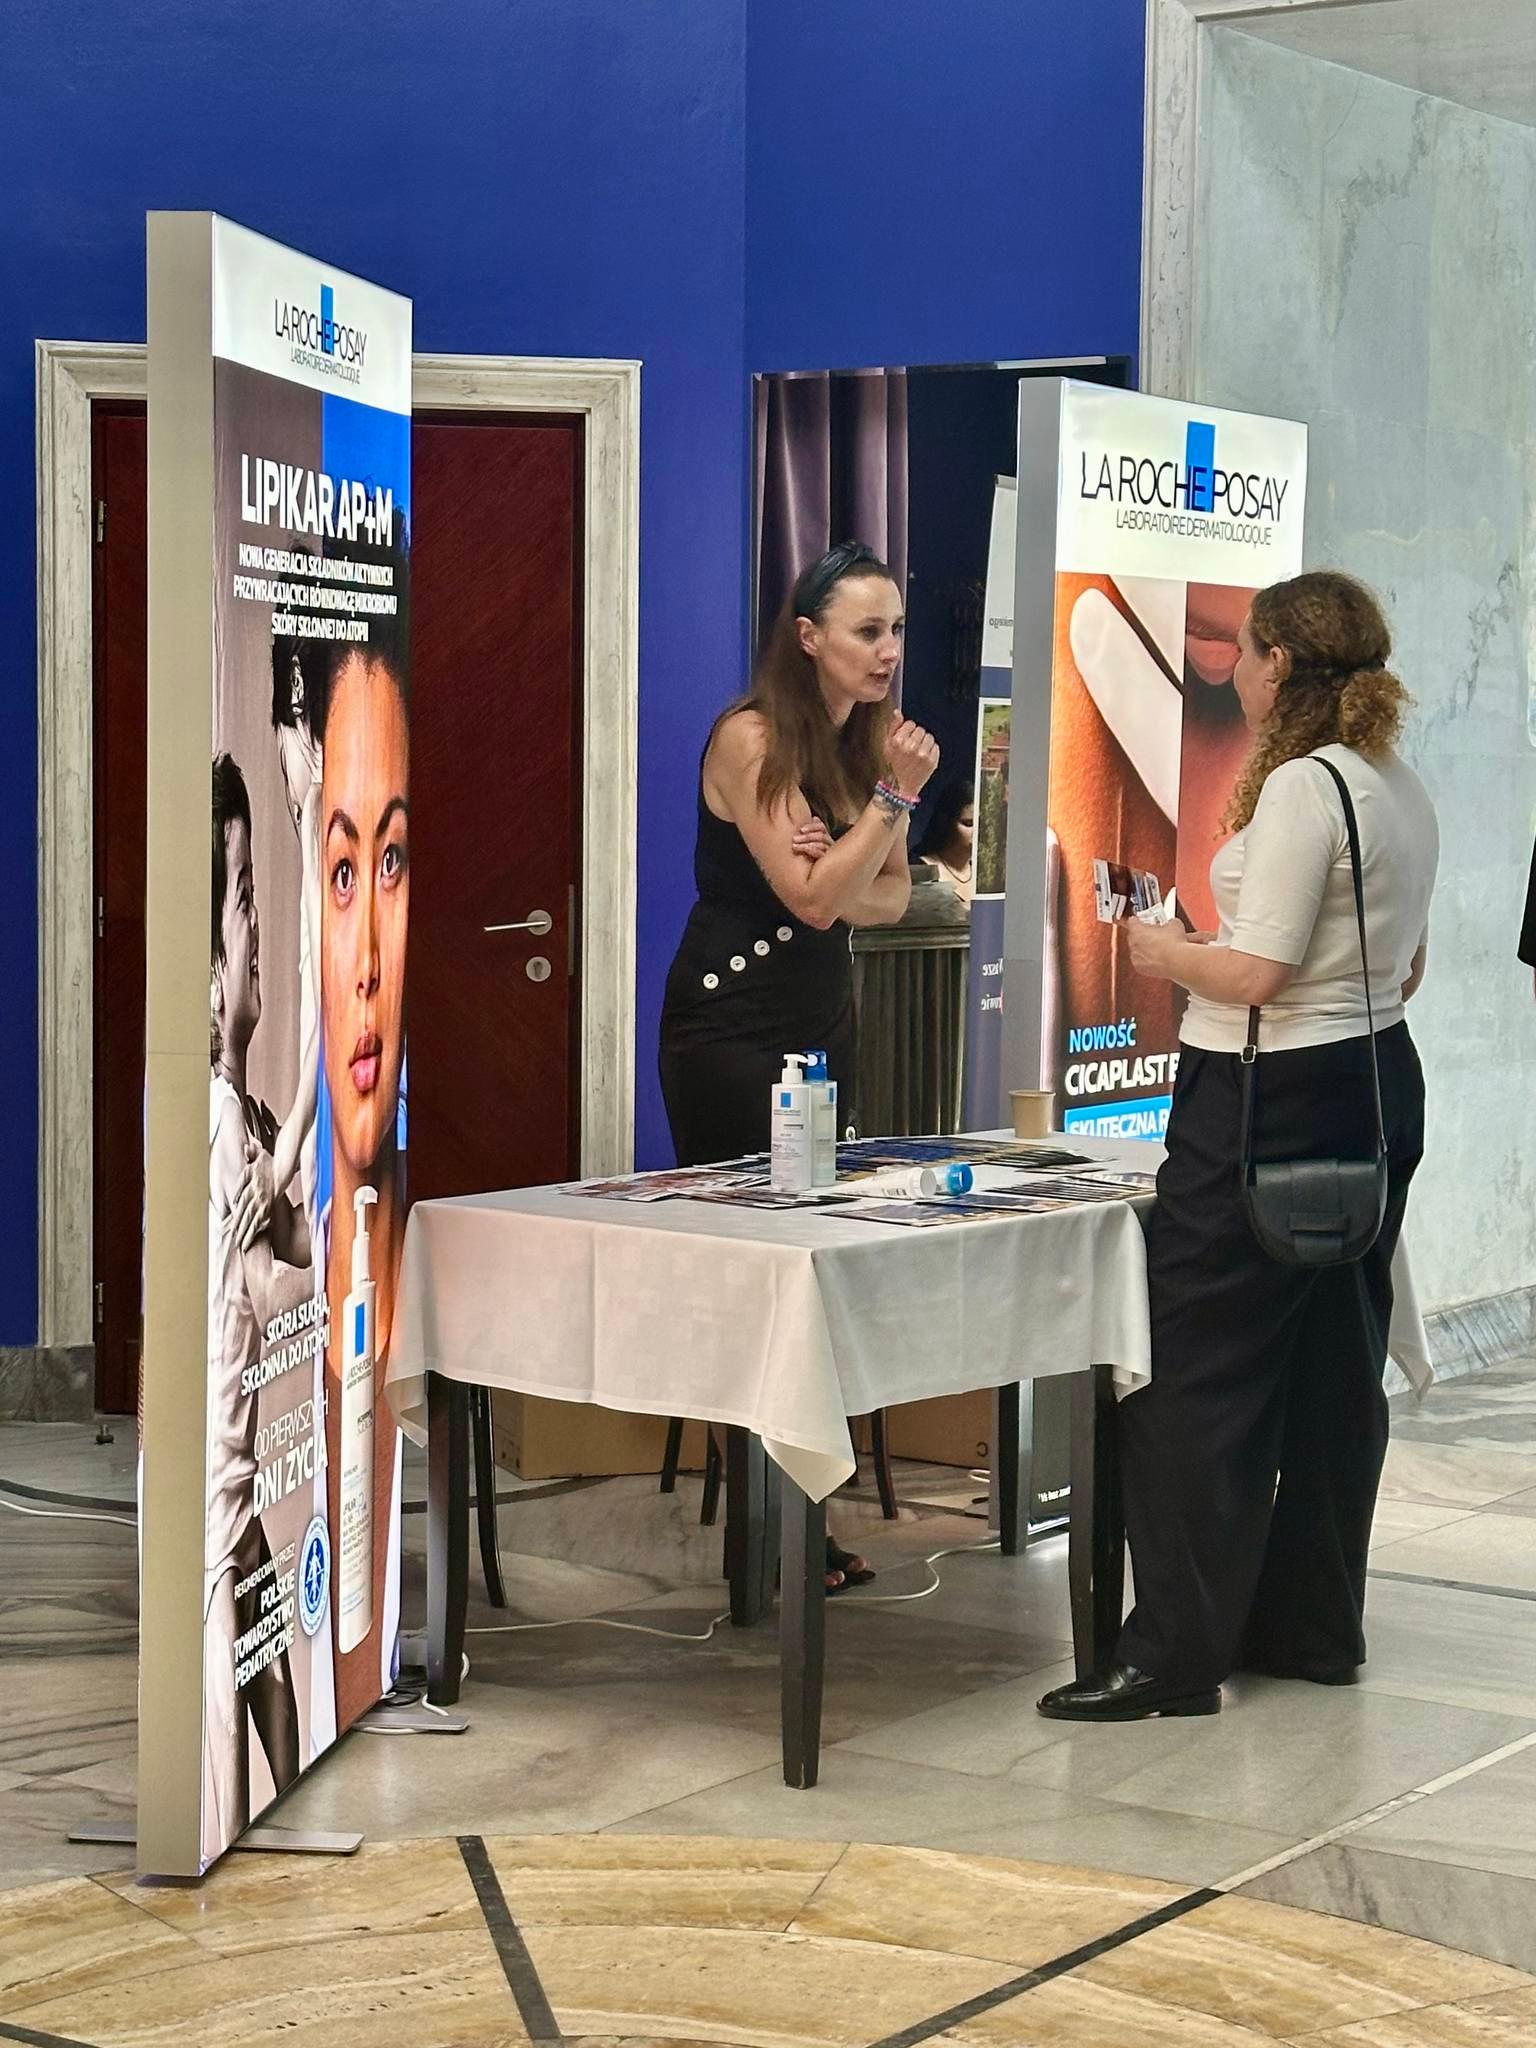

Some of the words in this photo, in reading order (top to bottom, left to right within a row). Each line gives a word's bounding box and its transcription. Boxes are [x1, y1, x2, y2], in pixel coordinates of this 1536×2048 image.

[275, 298, 290, 341] LA
[332, 322, 367, 367] POSAY
[241, 453, 335, 539] LIPIKAR
[337, 478, 393, 547] AP+M
[1081, 451, 1114, 502] LA
[1118, 456, 1207, 512] ROCHE
[1212, 470, 1288, 522] POSAY
[1116, 508, 1186, 537] LABORATOIRE
[1187, 518, 1271, 549] DERMATOLOGIQUE
[238, 543, 263, 570] NOWA
[264, 548, 307, 575] GENERACJA
[271, 608, 297, 636] SKÓRY
[336, 619, 346, 641] DO
[1069, 1017, 1137, 1054] NOWOŚĆ
[1064, 1053, 1168, 1096] CICAPLAST
[1069, 1110, 1157, 1138] SKUTECZNA
[266, 1308, 298, 1348] SKÓRA
[241, 1348, 288, 1396] SKŁONNA
[288, 1340, 301, 1369] DO
[302, 1323, 330, 1362] ATOPII
[254, 1428, 270, 1461] OD
[253, 1457, 282, 1518] DNI
[285, 1428, 328, 1495] ŻYCIA
[260, 1567, 295, 1614] POLSKIE
[233, 1595, 295, 1663] TOWARZYSTWO
[234, 1621, 295, 1692] PEDIATRYCZNE
